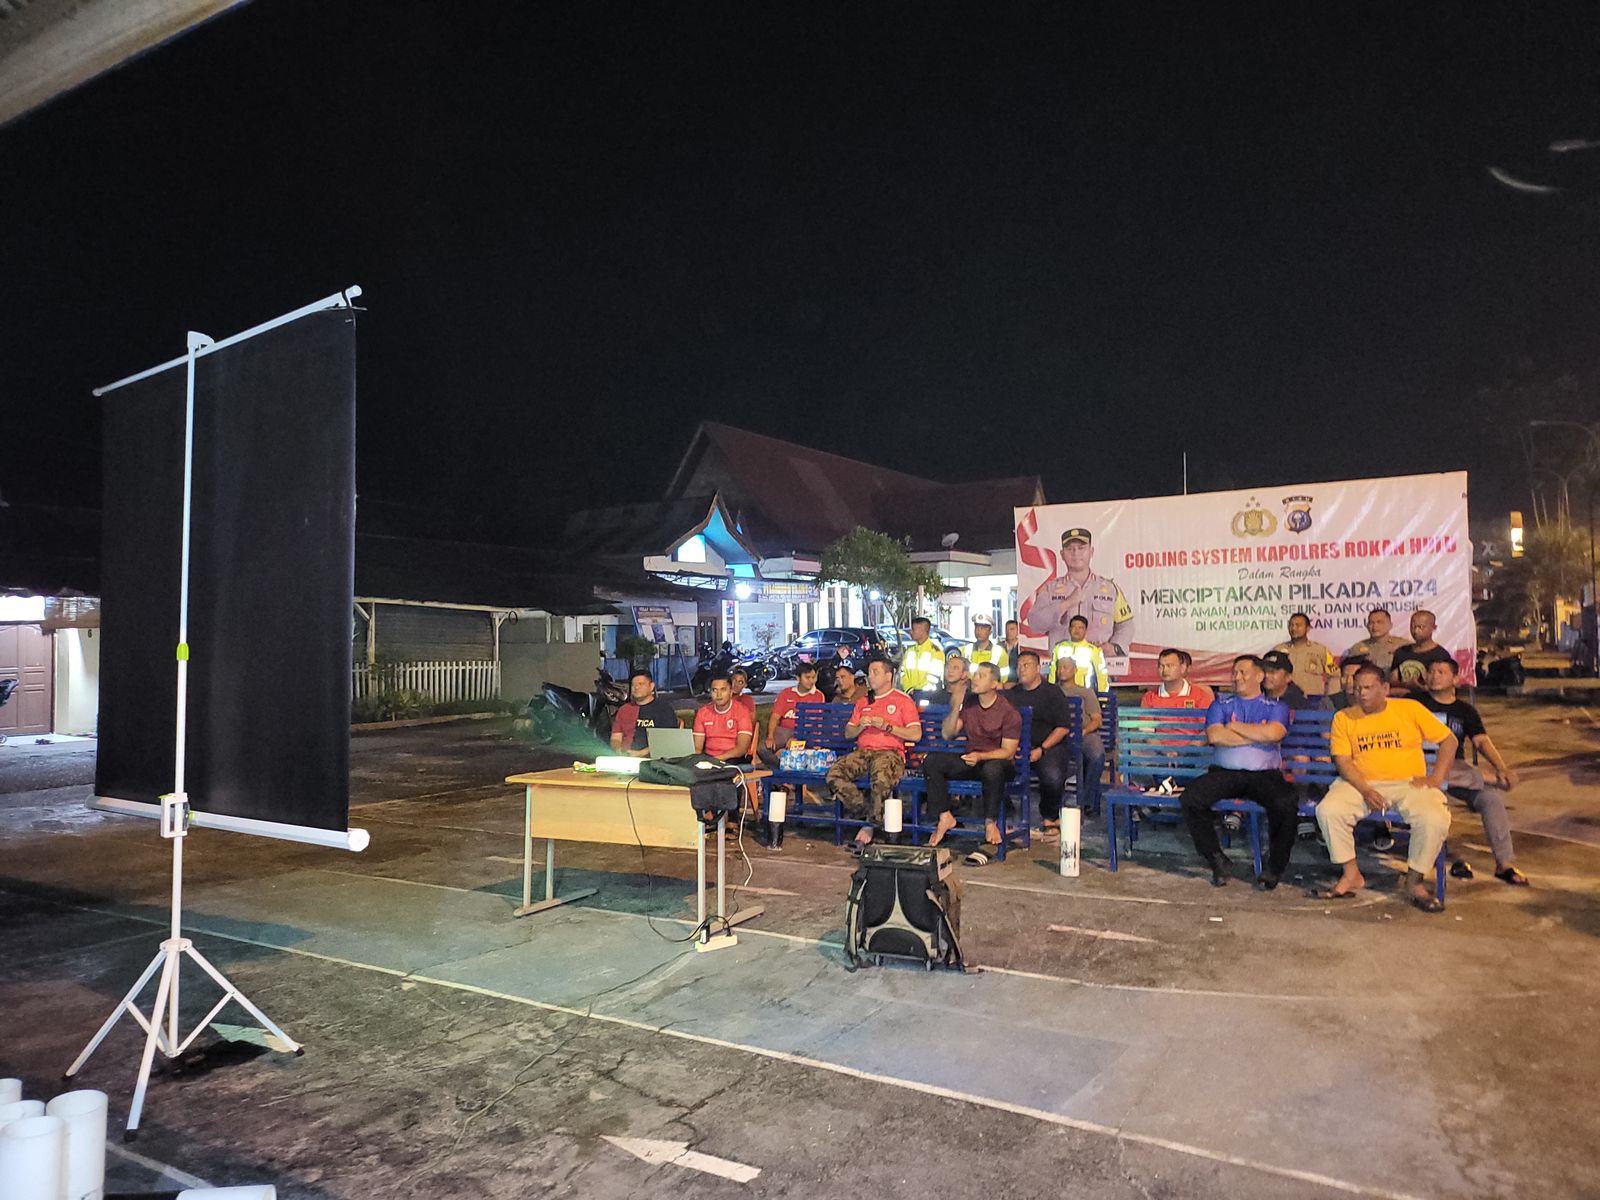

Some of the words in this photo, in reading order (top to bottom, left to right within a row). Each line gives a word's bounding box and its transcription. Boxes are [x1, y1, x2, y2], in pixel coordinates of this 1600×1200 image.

[1125, 551, 1187, 568] COOLING
[1191, 548, 1252, 565] SYSTEM
[1257, 543, 1340, 562] KAPOLRES
[1345, 539, 1405, 558] ROKAN
[1238, 567, 1274, 581] Dalam
[1280, 565, 1321, 581] Rangka
[1140, 584, 1283, 605] MENCIPTAKAN
[1289, 580, 1381, 600] PILKADA
[1388, 578, 1437, 598] 2024
[1156, 606, 1188, 618] YANG
[1190, 606, 1230, 619] AMAN,
[1233, 605, 1276, 617] DAMAI,
[1325, 602, 1353, 614] DAN
[1195, 621, 1207, 631] DI
[1209, 619, 1283, 631] KABUPATEN
[636, 719, 655, 728] TICA
[1358, 743, 1374, 752] MY
